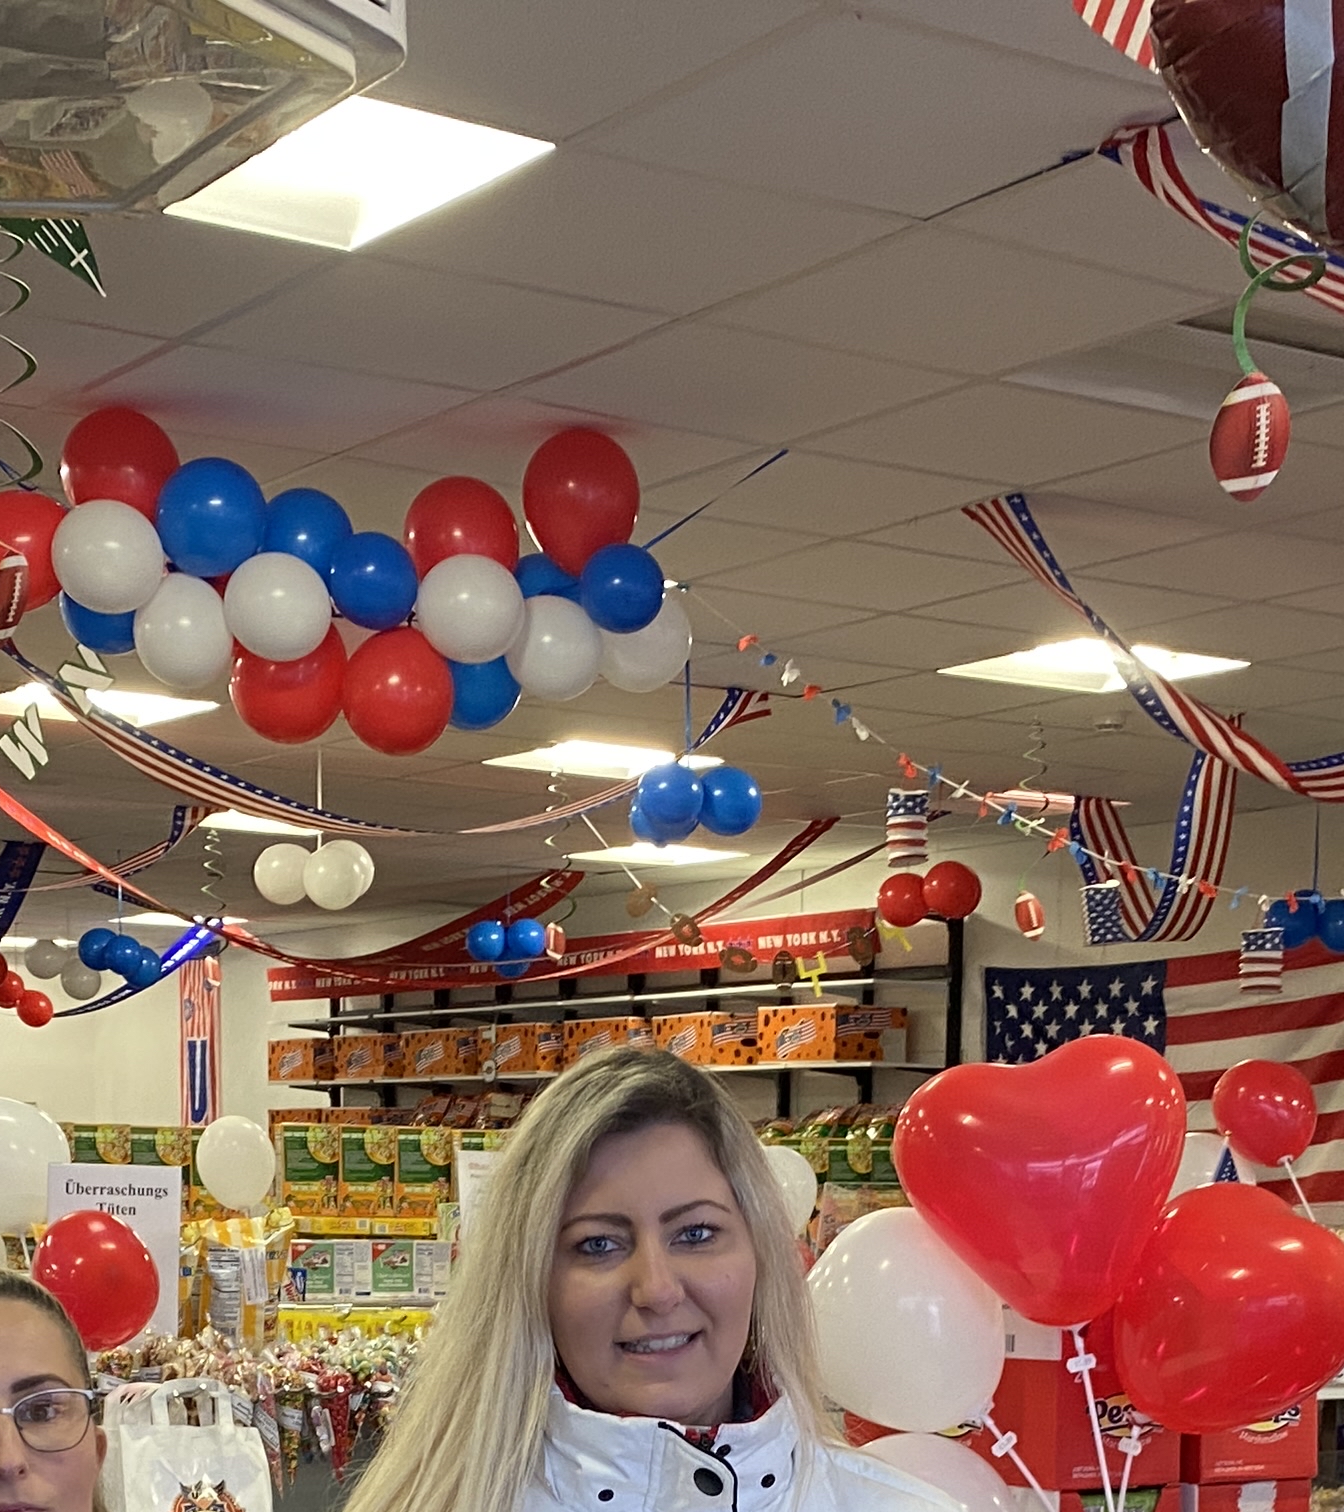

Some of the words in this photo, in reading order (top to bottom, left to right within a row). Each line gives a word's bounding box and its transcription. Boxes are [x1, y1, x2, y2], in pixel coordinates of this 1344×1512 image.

[758, 935, 783, 949] NEW
[786, 932, 816, 948] YORK
[819, 930, 841, 944] N.Y.
[656, 946, 676, 958] NEW
[65, 1179, 168, 1199] Überraschungs
[96, 1202, 136, 1215] Tüten
